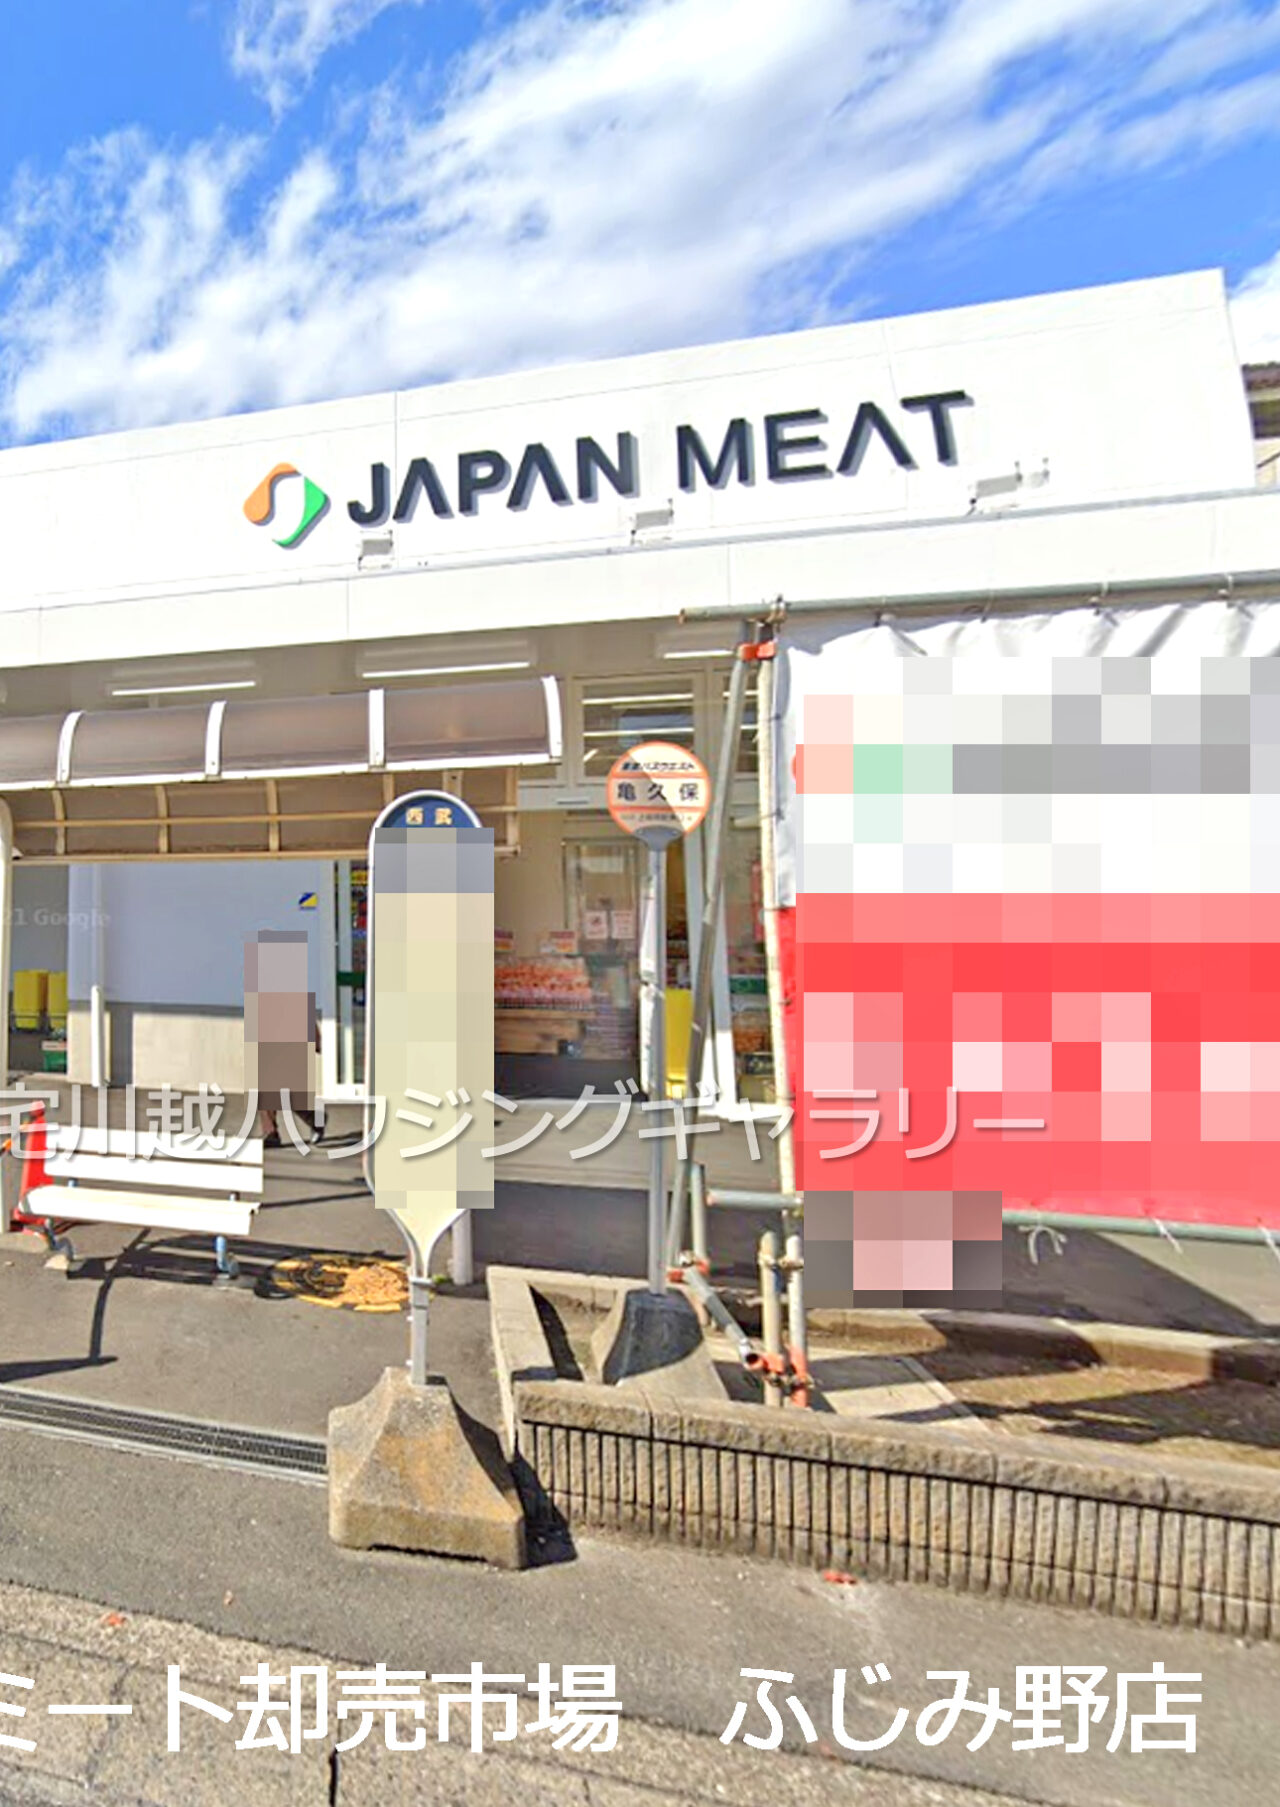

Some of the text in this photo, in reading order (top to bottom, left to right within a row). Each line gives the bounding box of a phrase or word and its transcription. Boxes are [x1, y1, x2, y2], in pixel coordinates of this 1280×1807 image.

[347, 390, 974, 526] JAPAN MEAT
[617, 782, 699, 801] 亀久保
